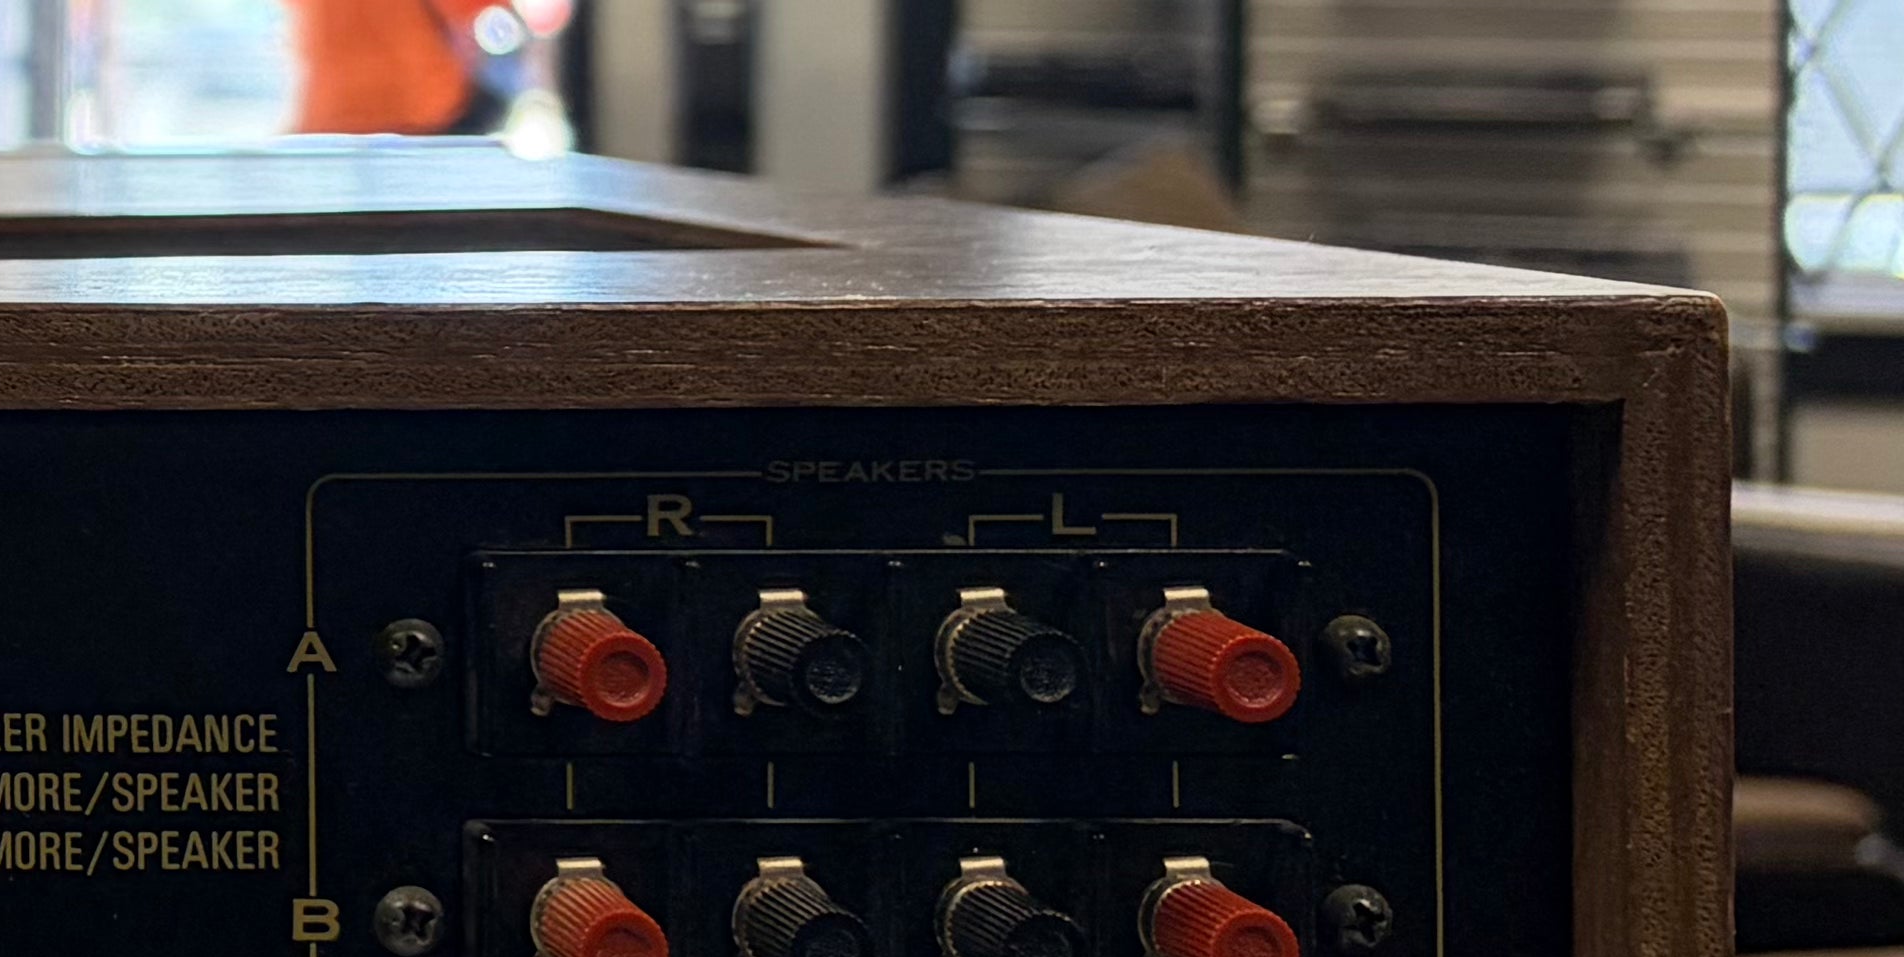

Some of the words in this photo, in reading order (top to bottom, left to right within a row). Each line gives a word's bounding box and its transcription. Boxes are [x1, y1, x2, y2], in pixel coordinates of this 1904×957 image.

[765, 458, 977, 483] SPEAKERS
[647, 494, 694, 537] R
[1052, 493, 1097, 535] L
[284, 630, 339, 673] A
[62, 713, 278, 754] IMPEDANCE
[292, 898, 341, 942] B
